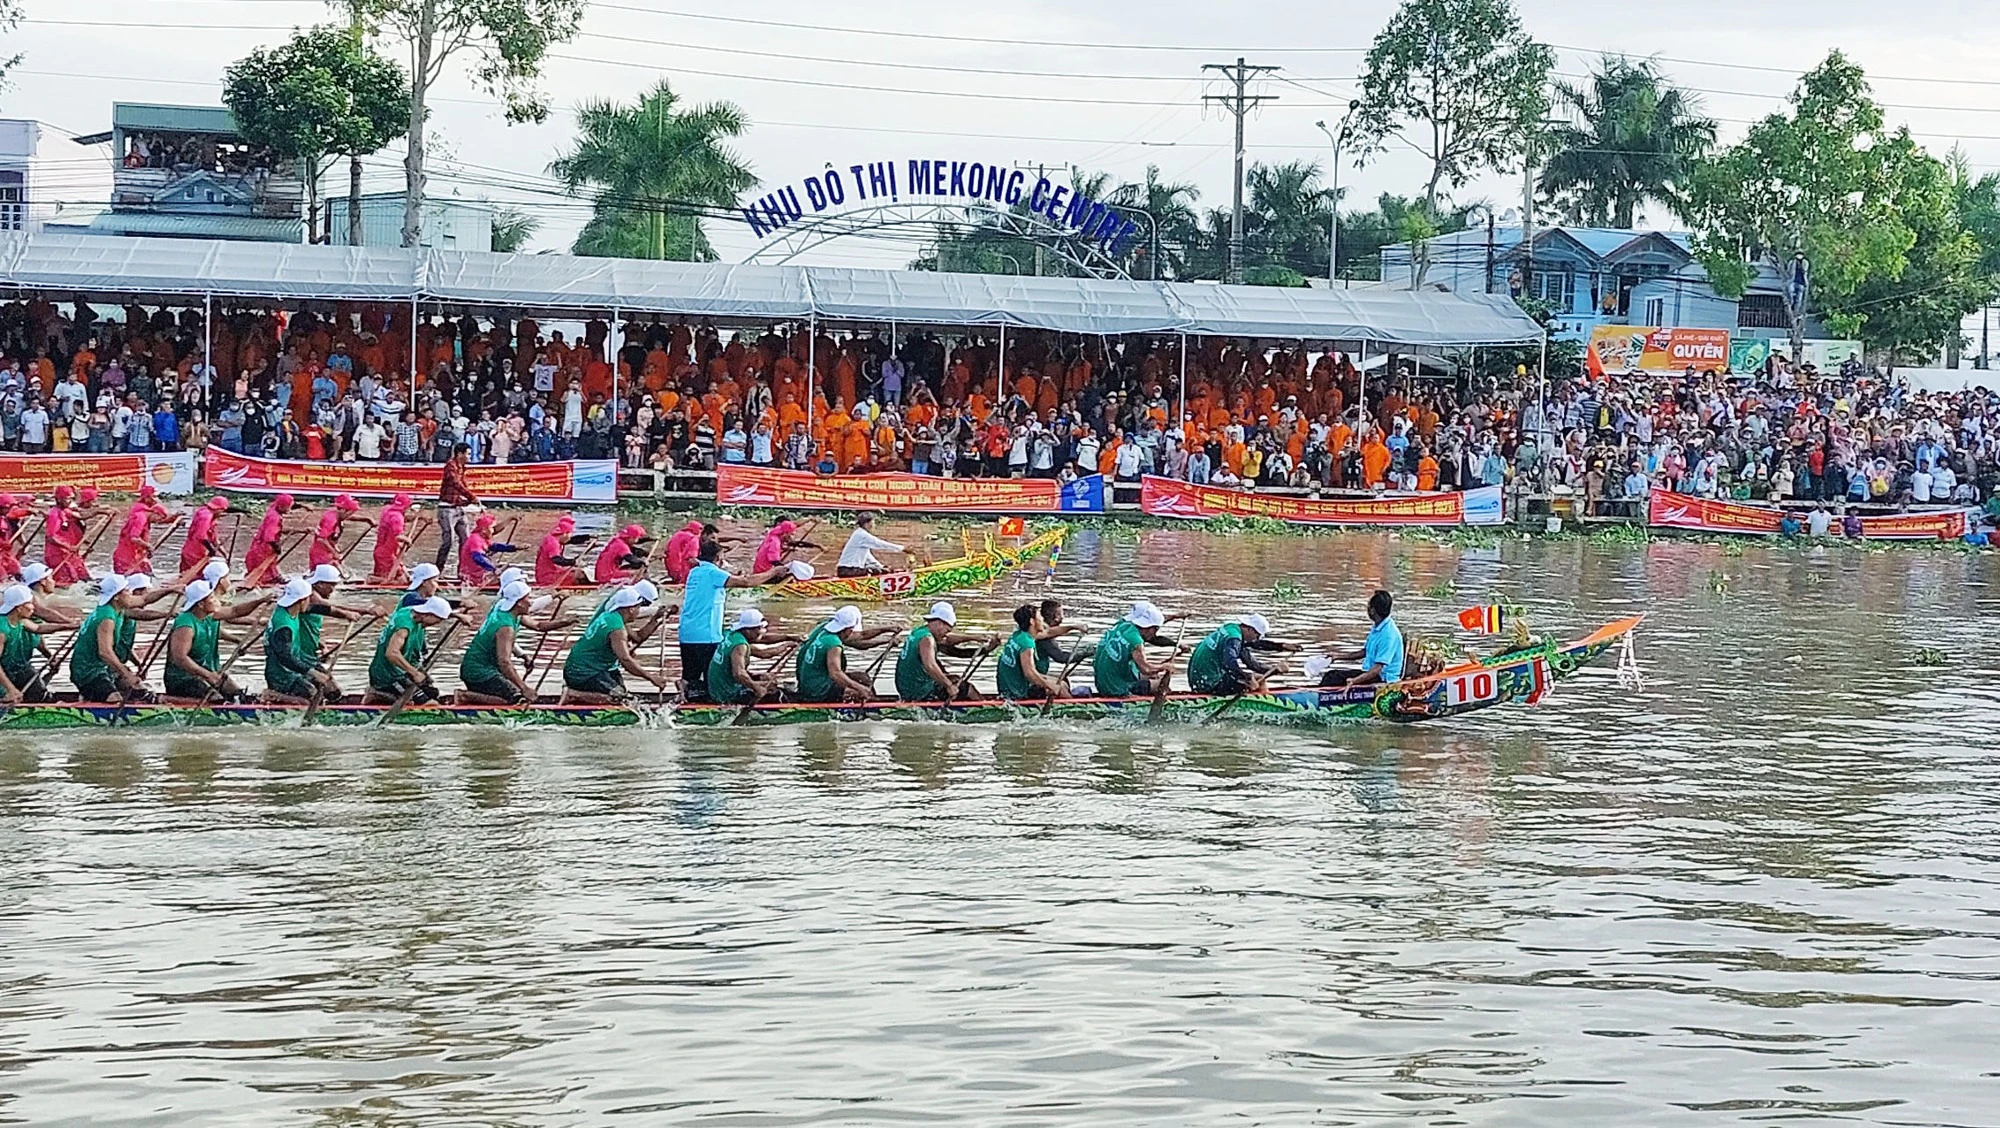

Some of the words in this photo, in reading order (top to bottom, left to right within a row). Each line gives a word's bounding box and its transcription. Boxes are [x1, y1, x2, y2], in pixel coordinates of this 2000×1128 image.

[743, 185, 802, 239] KHU
[804, 163, 845, 212] ĐÔ
[850, 161, 899, 203] THỊ
[908, 159, 1024, 206] MEKONG
[1030, 178, 1138, 255] CENTRE
[883, 575, 912, 592] 32
[1452, 673, 1492, 702] 10
